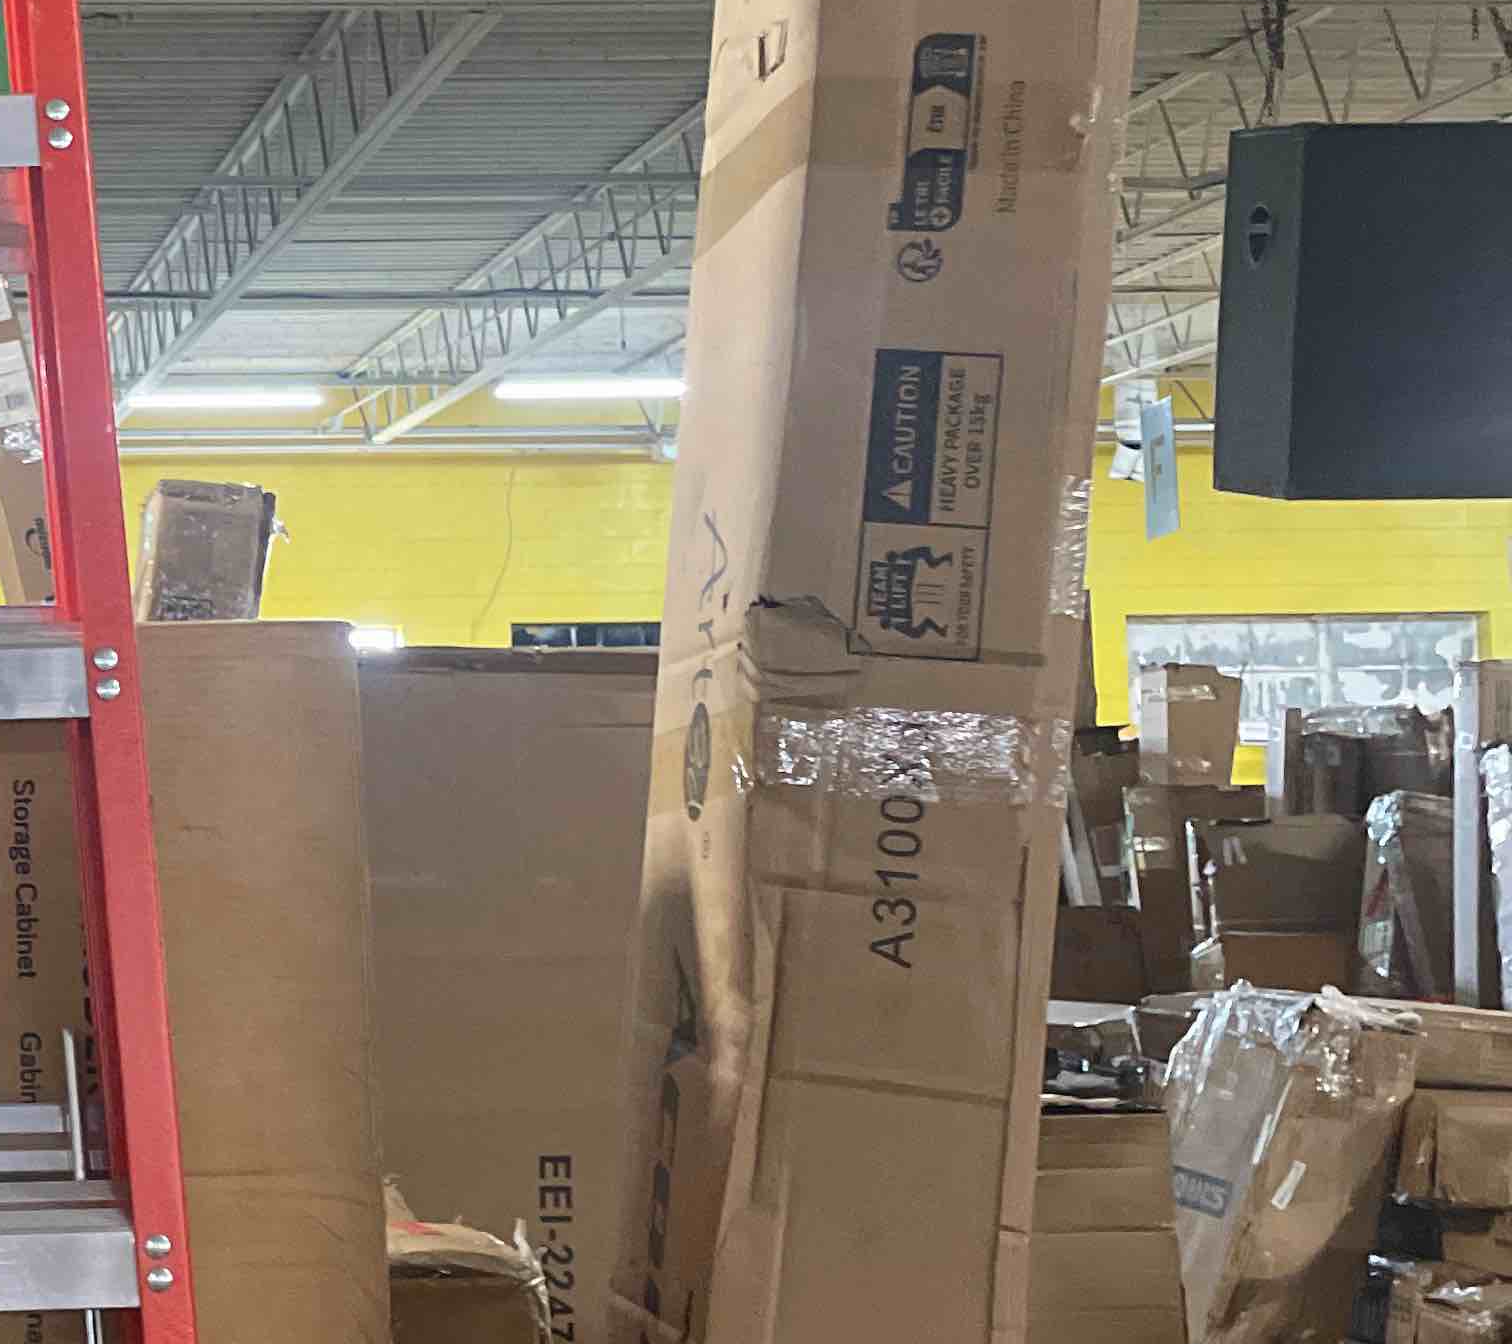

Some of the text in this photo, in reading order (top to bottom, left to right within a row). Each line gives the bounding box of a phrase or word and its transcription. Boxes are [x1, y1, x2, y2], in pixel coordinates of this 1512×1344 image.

[1001, 80, 1025, 136] China
[994, 160, 1019, 214] Made
[893, 364, 922, 475] CAUTION
[938, 367, 968, 513] HEAVY PACKAGE
[962, 392, 991, 490] OVER 15kg
[872, 561, 888, 611] TEAM
[892, 568, 908, 610] LIFT
[8, 778, 39, 979] Storage Cabinet
[18, 1032, 42, 1104] Gabin
